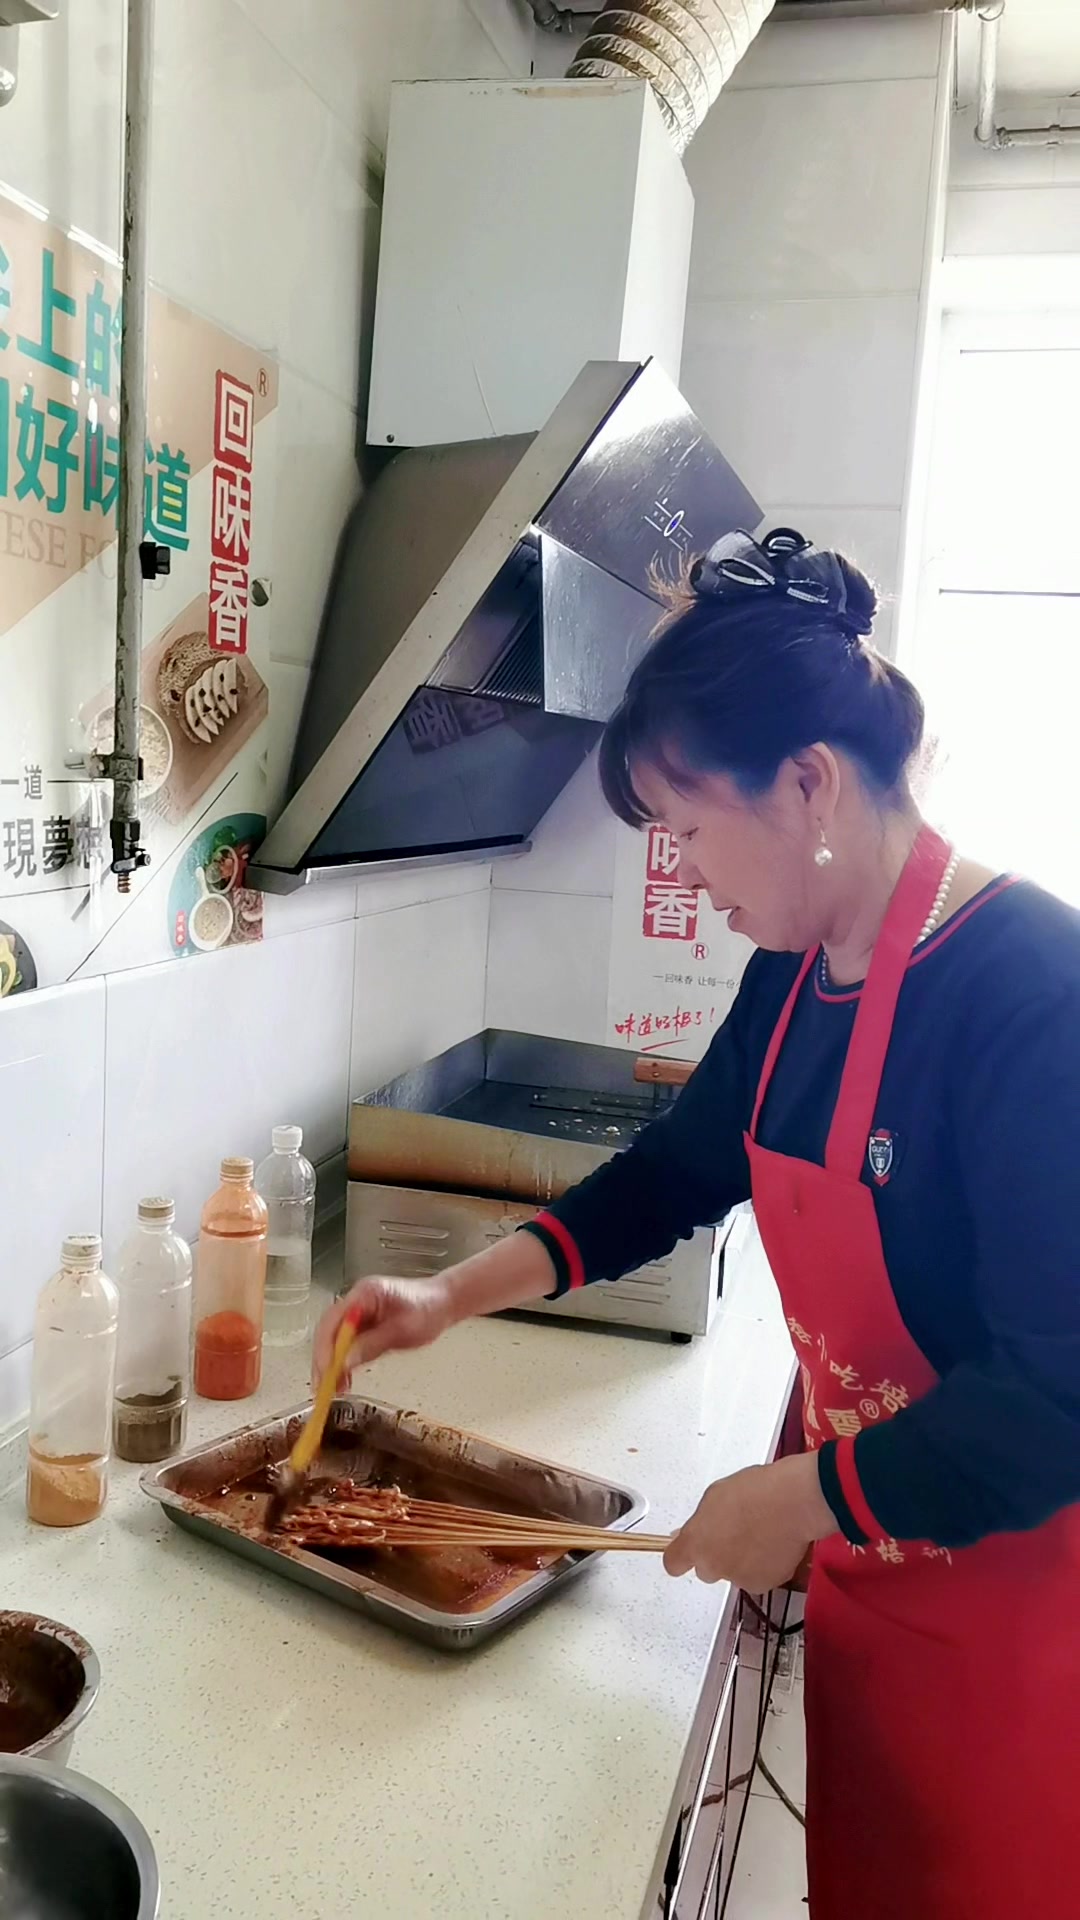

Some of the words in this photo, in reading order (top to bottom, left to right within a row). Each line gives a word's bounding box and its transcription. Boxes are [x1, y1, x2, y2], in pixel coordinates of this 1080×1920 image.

[0, 243, 122, 398] 上的
[0, 375, 190, 552] 好味道
[210, 374, 254, 650] 回味香
[698, 976, 740, 989] 让每一份
